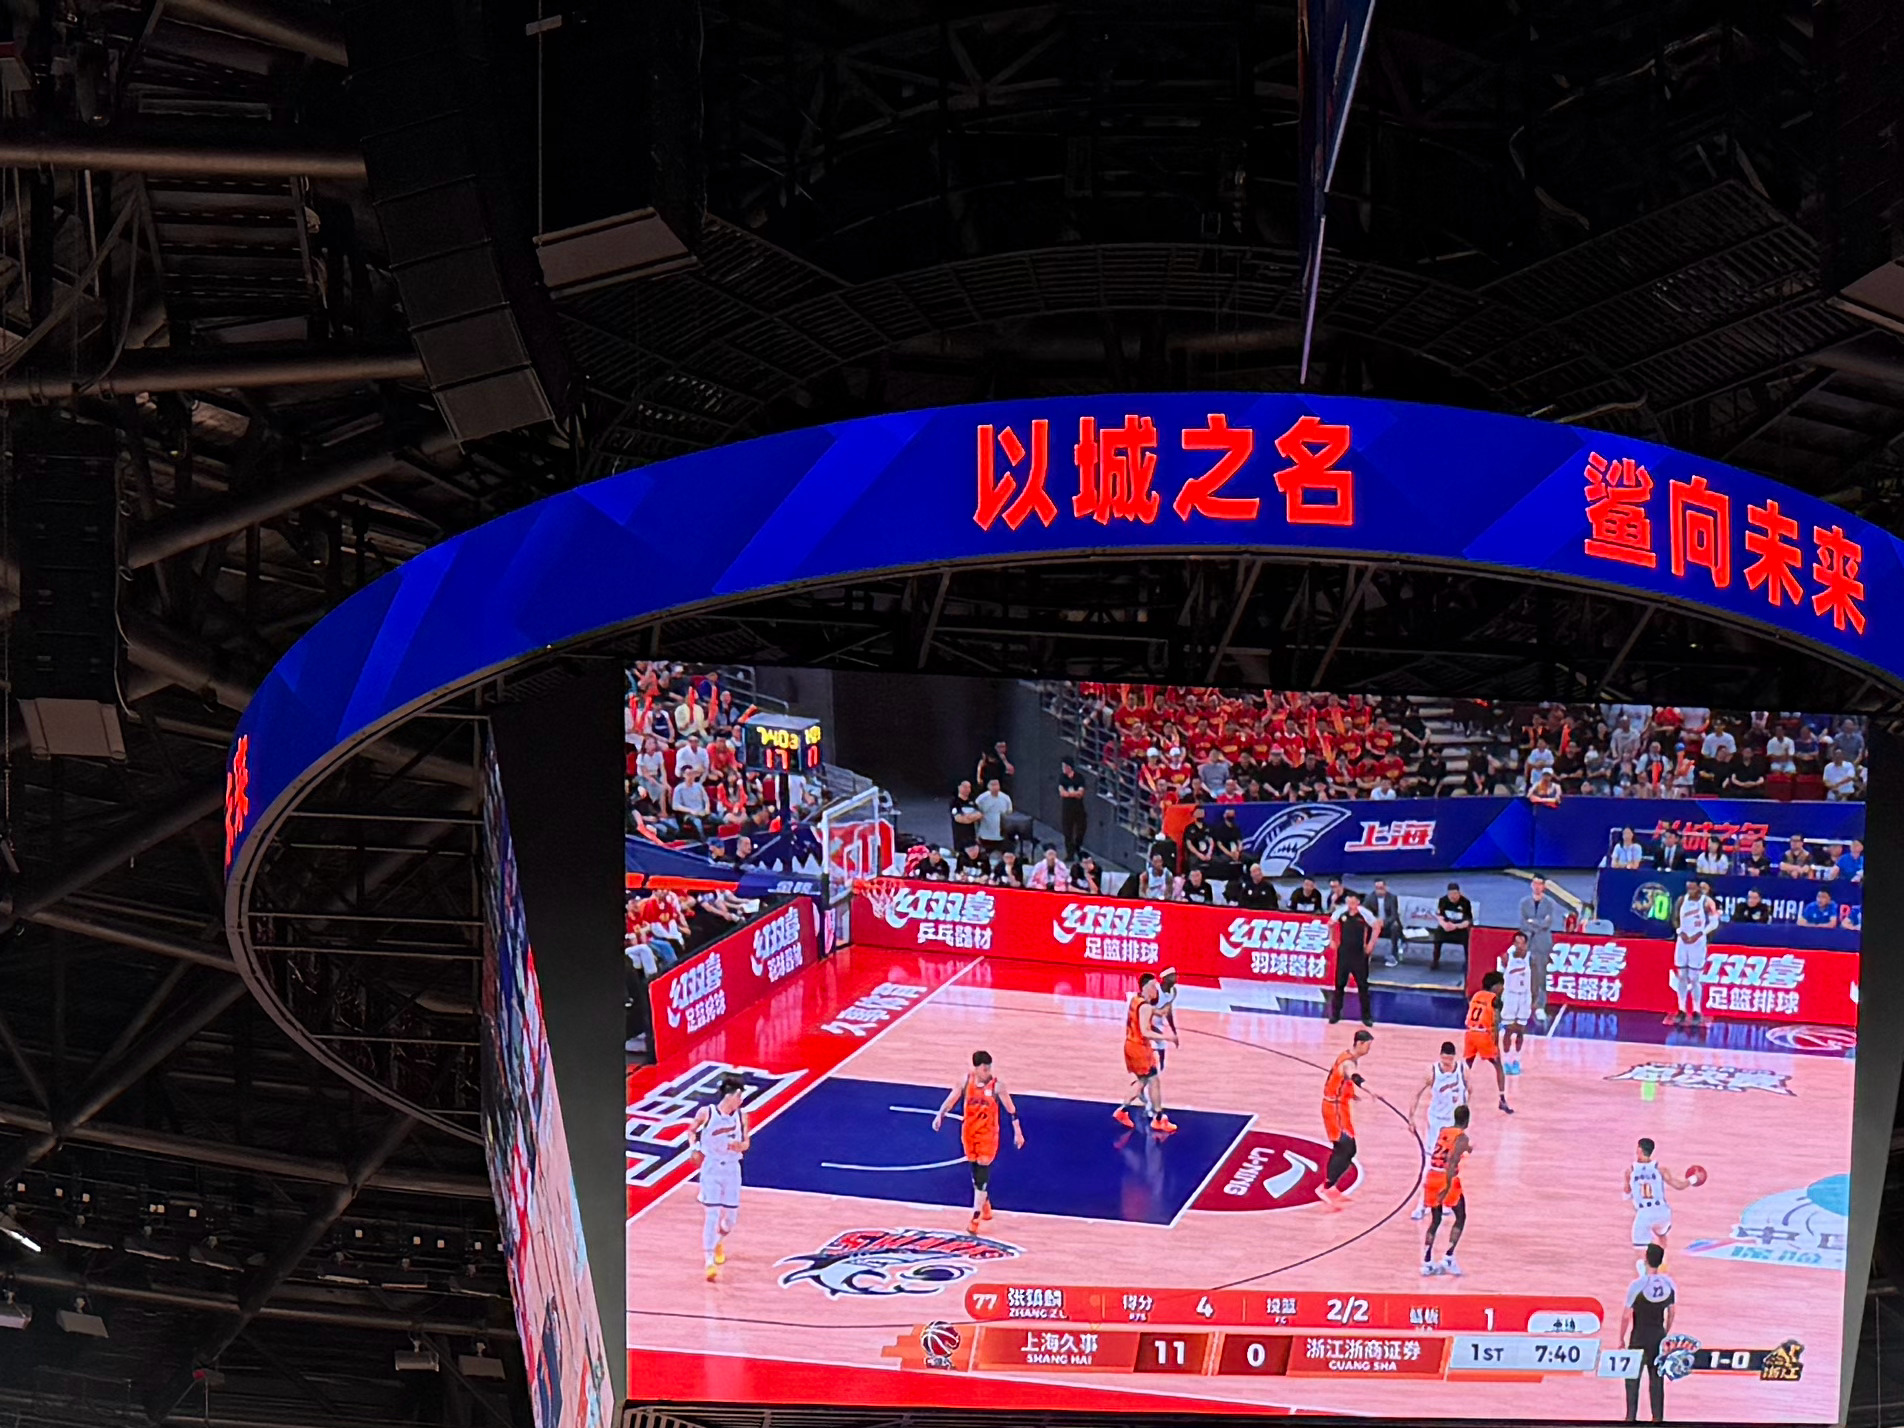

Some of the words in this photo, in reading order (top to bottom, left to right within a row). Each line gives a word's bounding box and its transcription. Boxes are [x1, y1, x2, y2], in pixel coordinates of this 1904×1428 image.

[975, 414, 1354, 533] 以城之名
[1584, 451, 1869, 635] 鲨向未来
[1345, 820, 1436, 853] 上海
[893, 887, 995, 927] 红双喜
[1061, 903, 1162, 940] 红双喜
[917, 921, 992, 951] 乒乓器材
[1084, 938, 1159, 964] 足篮排球
[1228, 916, 1330, 954] 红双喜
[1250, 952, 1327, 977] 羽球器材
[1706, 987, 1800, 1014] 足篮排球
[972, 1294, 998, 1311] 77
[1007, 1287, 1062, 1308] 张镇麟
[1123, 1294, 1154, 1311] 得分
[1195, 1296, 1214, 1319] 4
[1326, 1299, 1370, 1324] 2/2
[1484, 1307, 1495, 1330] 1
[1020, 1332, 1098, 1354] 上海久事
[1154, 1339, 1186, 1366] 11
[1247, 1343, 1265, 1368] 0
[1305, 1338, 1422, 1361] 浙江浙商证券
[1471, 1344, 1504, 1362] 1ST
[1534, 1344, 1581, 1364] 7:40
[1608, 1356, 1631, 1373] 17
[1709, 1350, 1751, 1370] 1-0
[1026, 1353, 1067, 1365] SHANG
[1070, 1354, 1093, 1366] HAI
[1373, 1361, 1398, 1372] SHA
